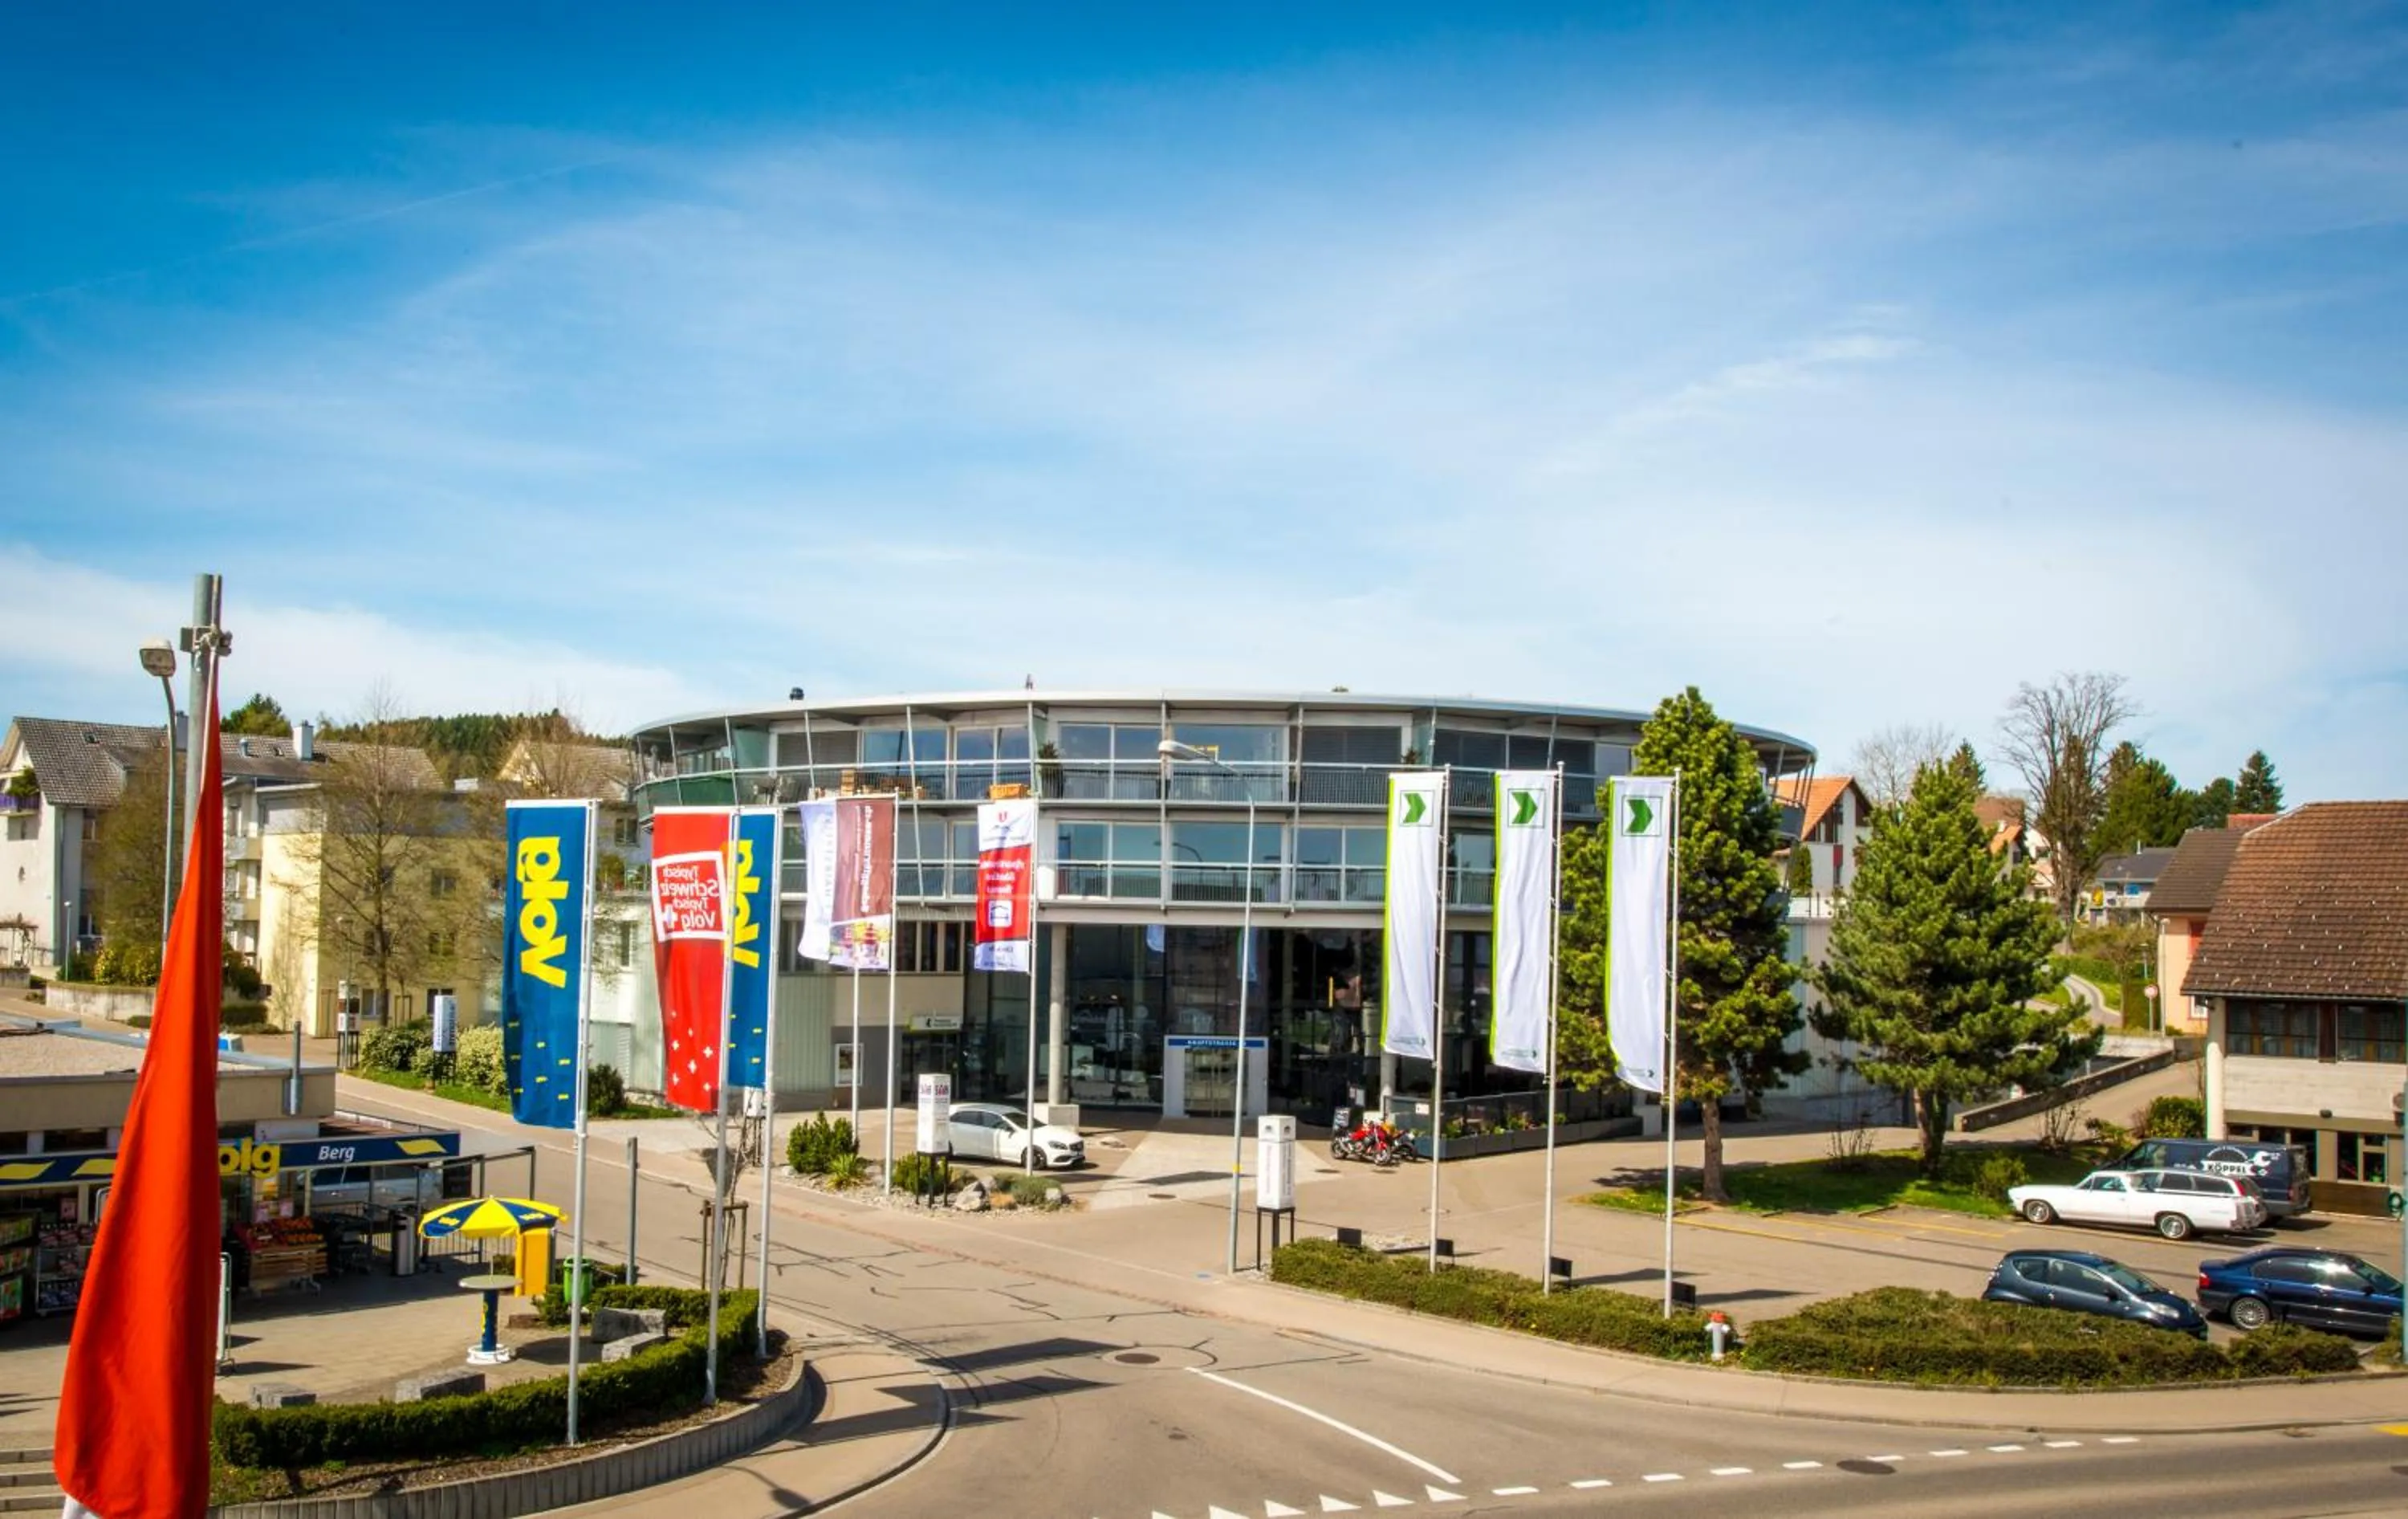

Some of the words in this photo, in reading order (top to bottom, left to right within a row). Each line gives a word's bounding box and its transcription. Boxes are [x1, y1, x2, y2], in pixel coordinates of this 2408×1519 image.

[218, 1137, 280, 1179] olg
[318, 1145, 356, 1163] Berg
[2207, 1162, 2246, 1172] KÖPPEL
